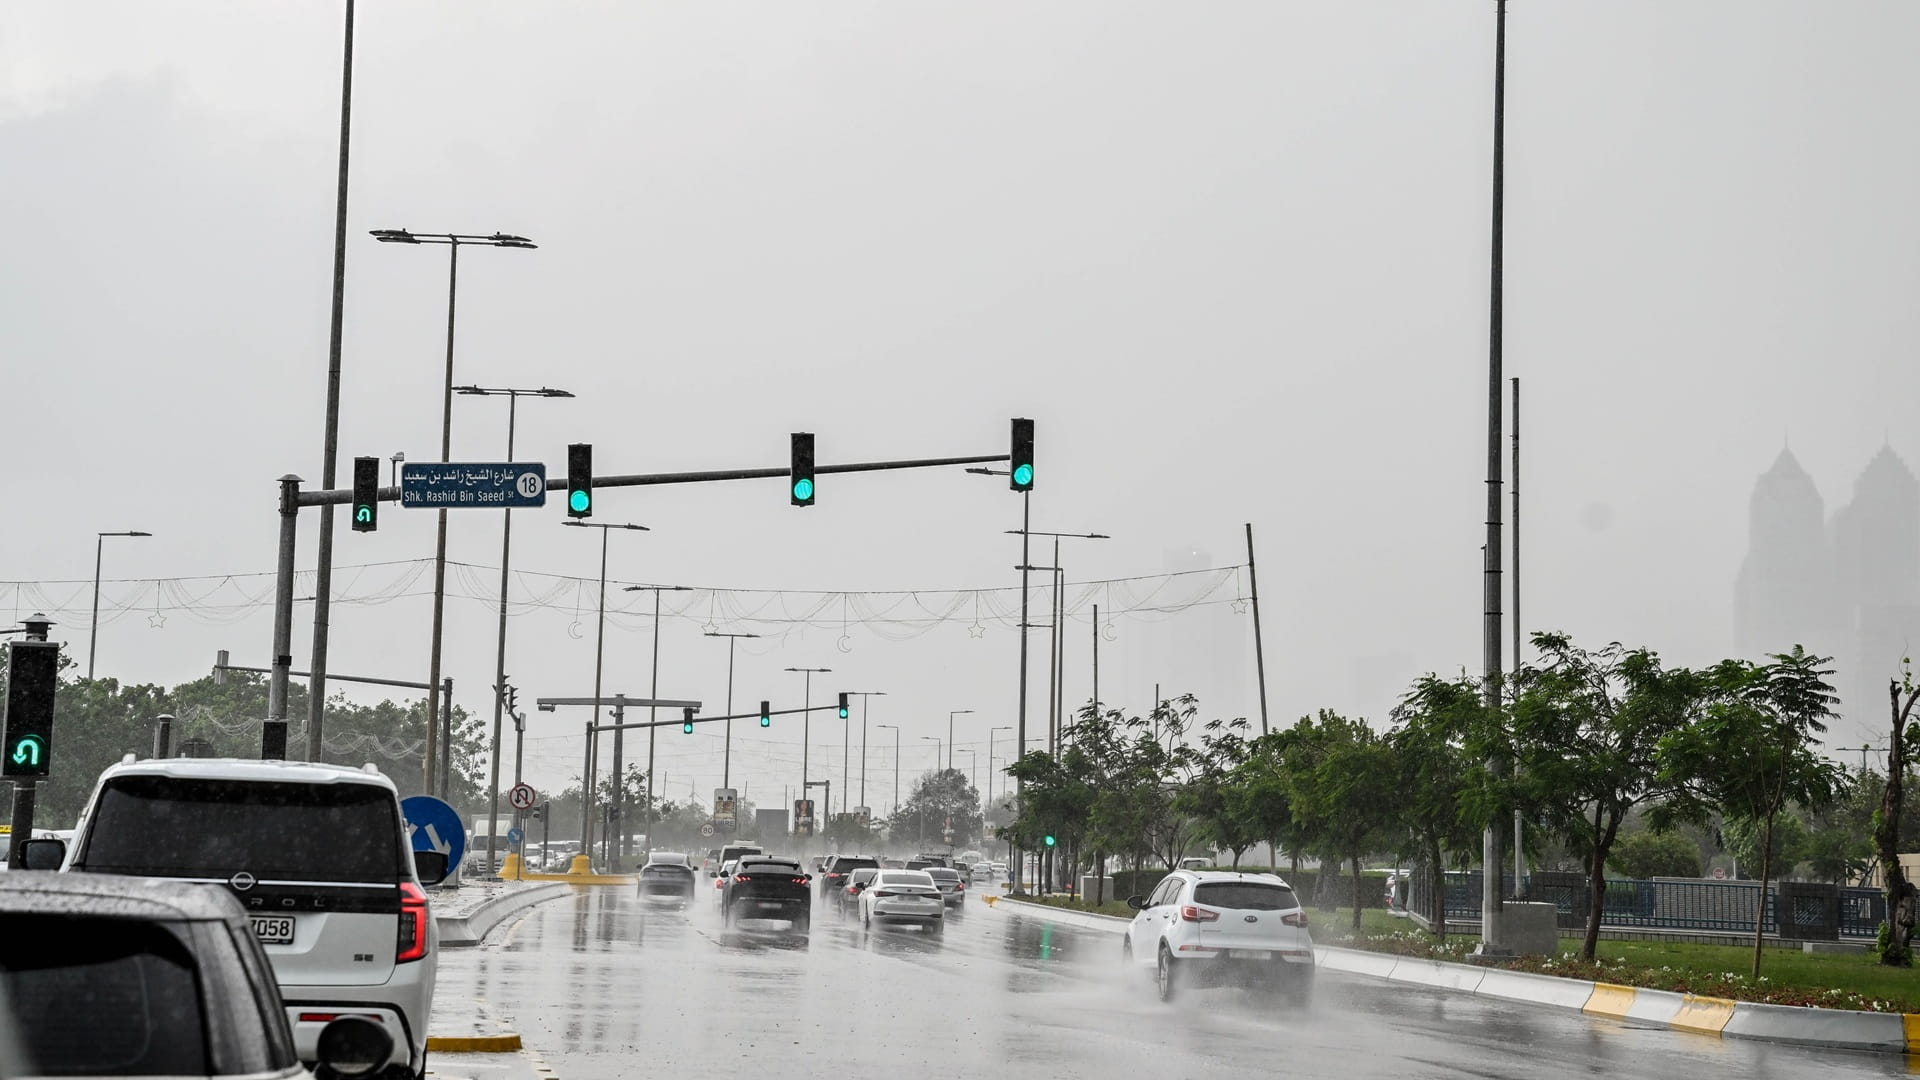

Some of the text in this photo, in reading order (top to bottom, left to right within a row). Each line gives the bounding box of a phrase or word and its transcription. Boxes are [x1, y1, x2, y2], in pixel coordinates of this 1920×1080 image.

[404, 469, 514, 486] شارع الشيخ راشد بن سعيد
[521, 476, 537, 494] 18
[404, 490, 423, 502] Shk.
[426, 490, 457, 502] Rashid
[460, 490, 474, 502] Bin
[477, 490, 504, 502] Saeed
[250, 897, 325, 907] ROL
